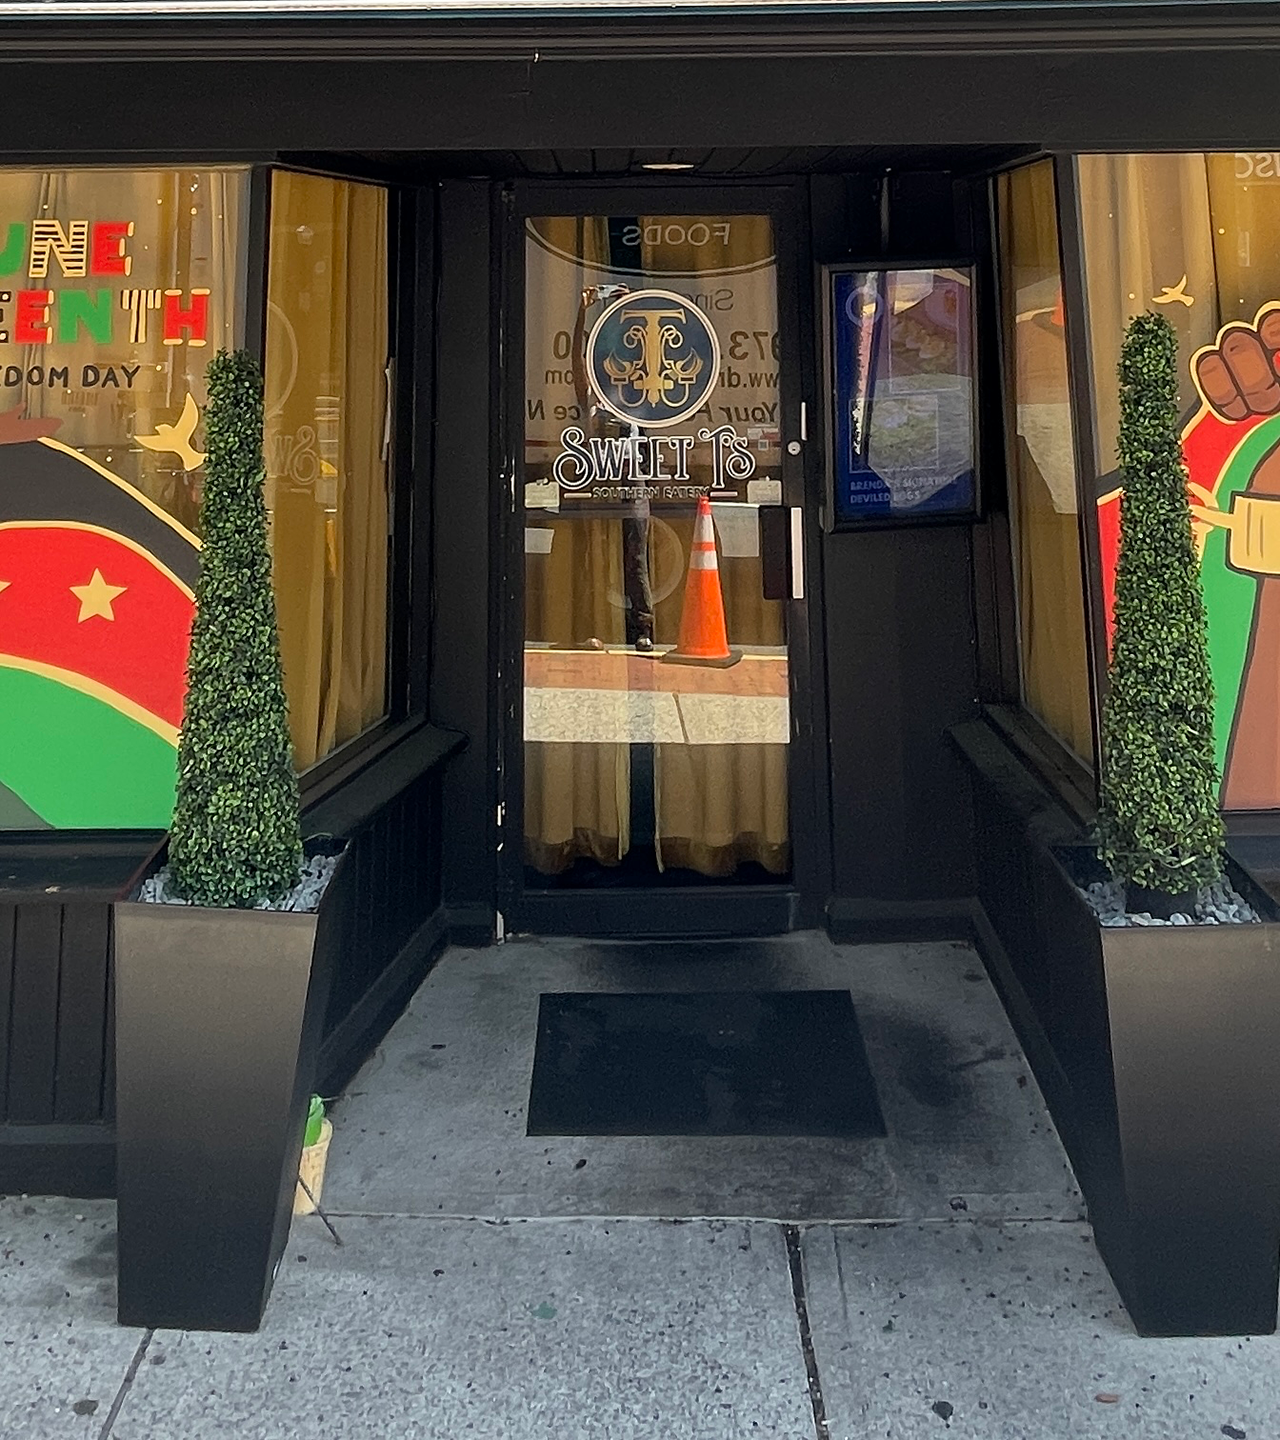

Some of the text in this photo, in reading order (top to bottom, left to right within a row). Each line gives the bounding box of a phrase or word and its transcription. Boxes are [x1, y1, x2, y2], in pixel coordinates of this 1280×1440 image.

[81, 363, 141, 389] DAY
[553, 426, 694, 490] SWEET
[592, 485, 710, 500] SOUTHERN EATERY
[850, 492, 891, 504] DEVILED
